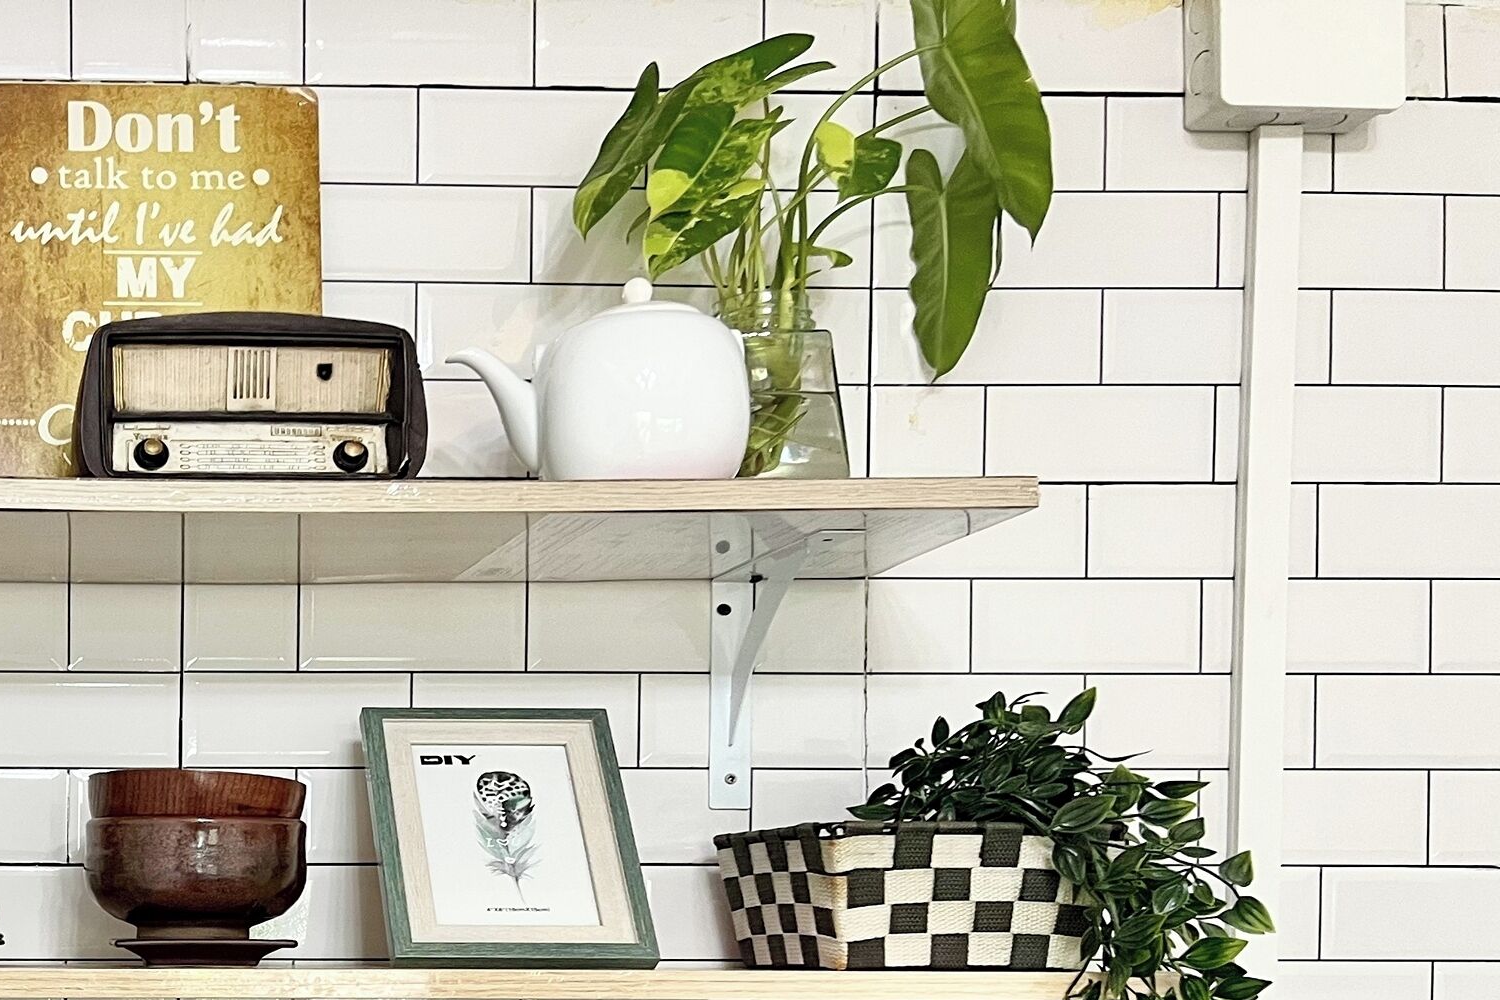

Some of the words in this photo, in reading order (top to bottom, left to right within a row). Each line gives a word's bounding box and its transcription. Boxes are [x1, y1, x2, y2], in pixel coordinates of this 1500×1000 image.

[66, 100, 241, 153] Don't
[58, 156, 130, 190] talk
[142, 166, 176, 190] to
[189, 170, 246, 190] me
[10, 201, 119, 246] until
[133, 203, 197, 246] I've
[209, 203, 284, 247] had
[116, 256, 191, 298] MY
[420, 755, 476, 765] DIY
